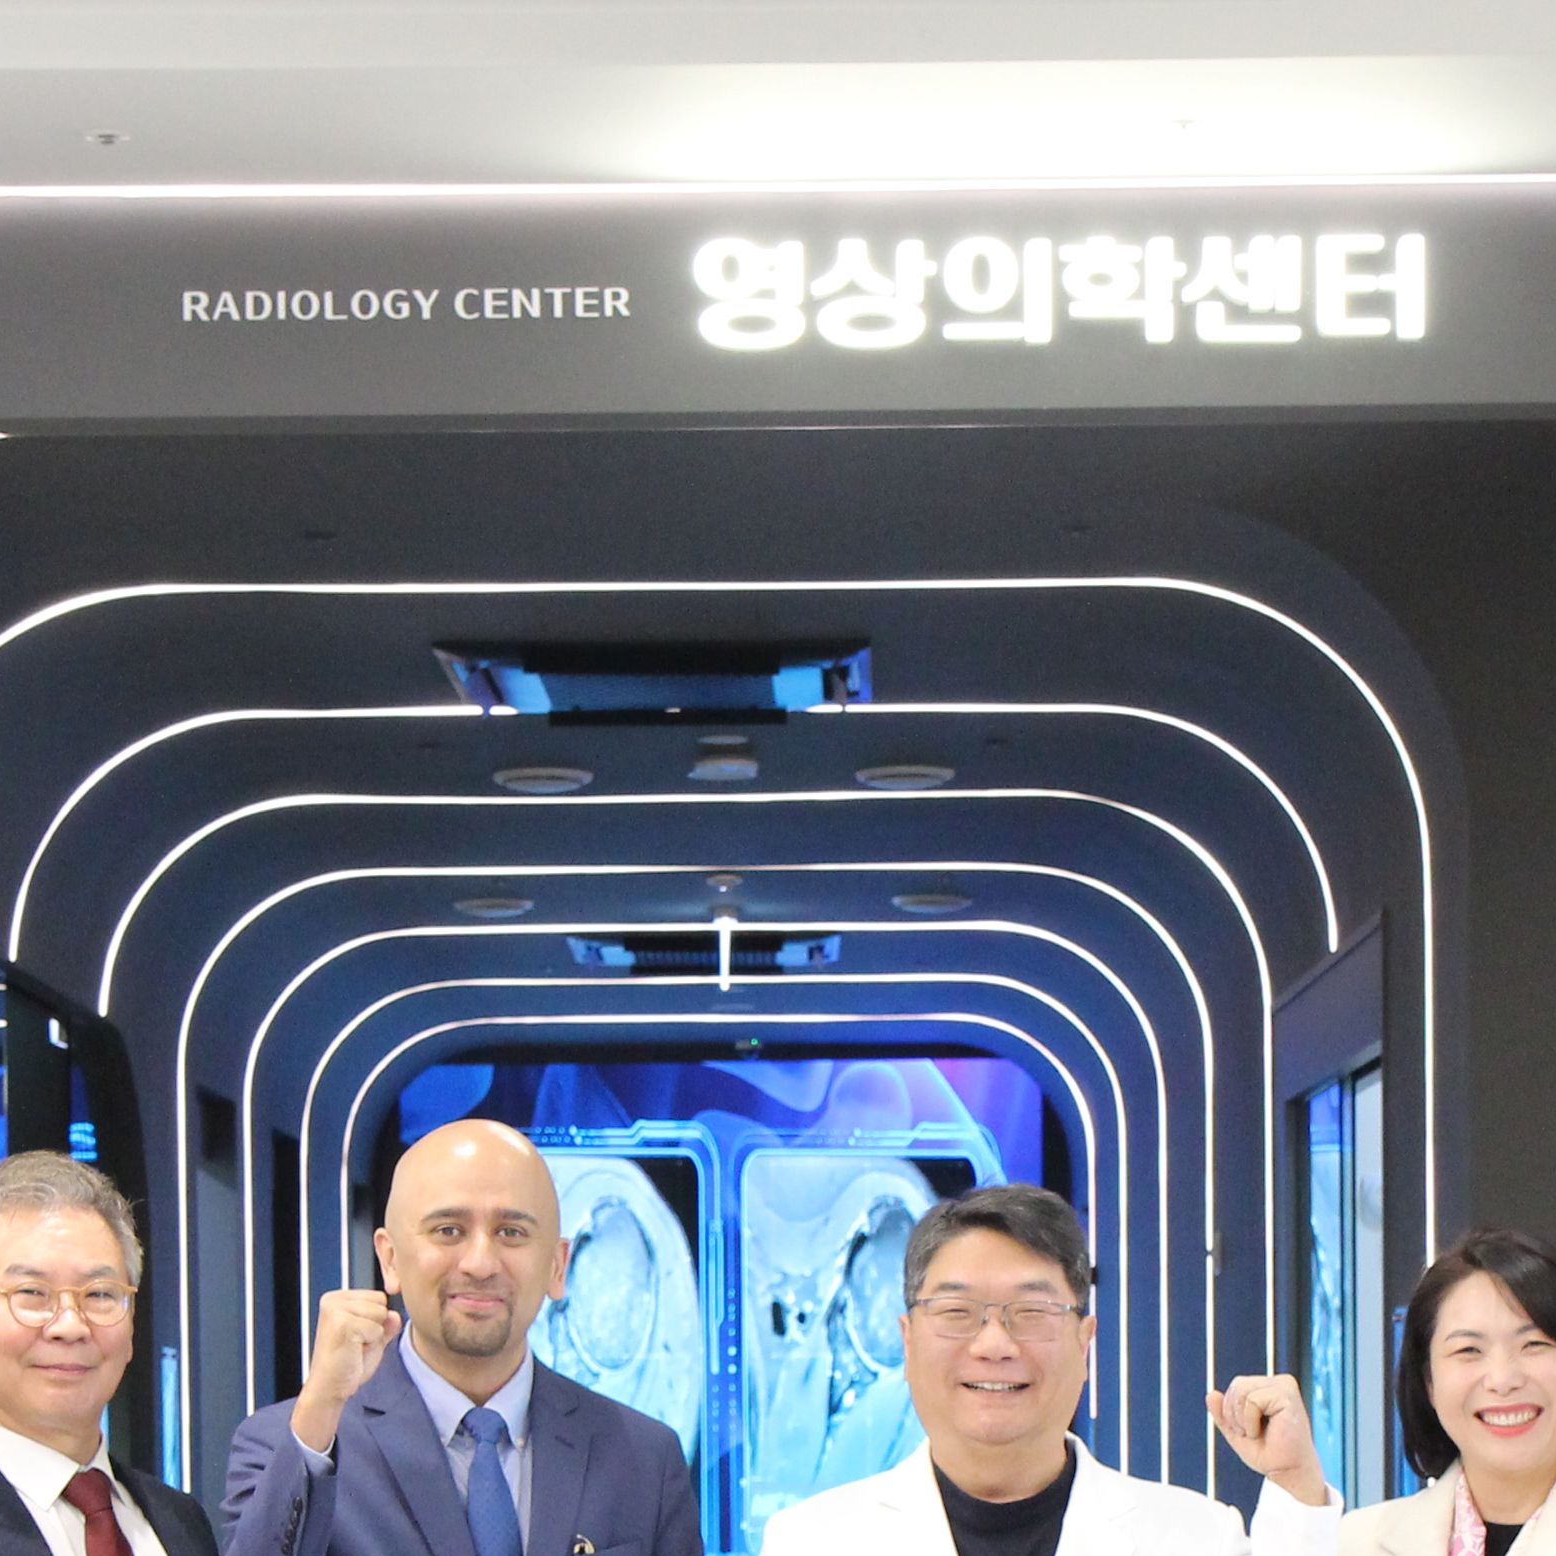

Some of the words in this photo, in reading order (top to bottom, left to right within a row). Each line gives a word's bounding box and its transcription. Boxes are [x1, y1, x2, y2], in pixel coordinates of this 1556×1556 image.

[182, 288, 439, 321] RADIOLOGY
[453, 286, 631, 320] CENTER
[691, 232, 1429, 350] 영상의학센터
